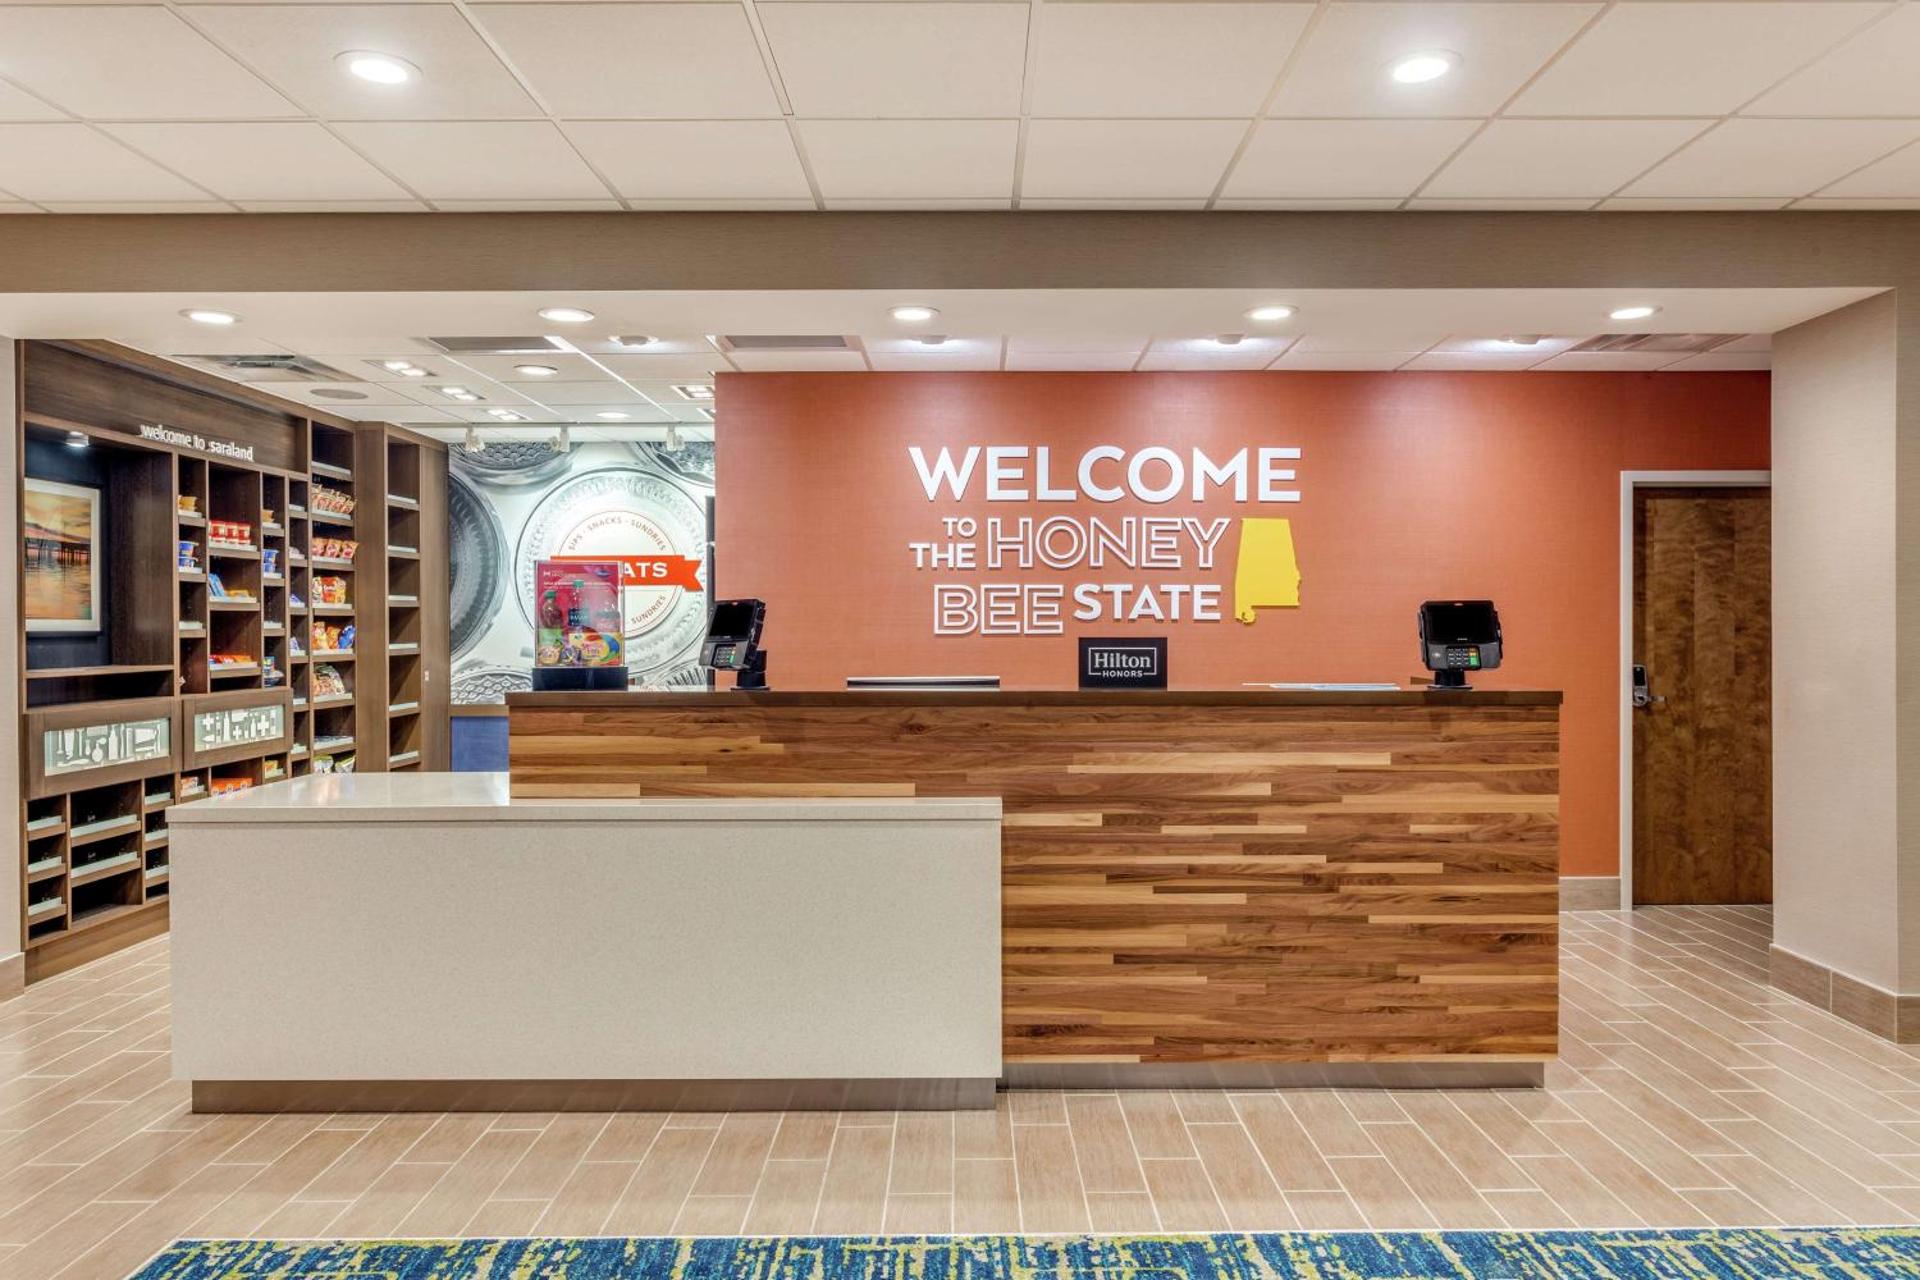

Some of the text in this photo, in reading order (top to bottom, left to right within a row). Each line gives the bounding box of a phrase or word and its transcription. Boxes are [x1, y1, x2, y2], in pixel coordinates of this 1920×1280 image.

[139, 425, 254, 462] welcome to saraland
[908, 446, 1301, 503] WELCOME
[568, 516, 667, 551] SIPS SNACKS SUNDRIES
[909, 516, 1231, 569] TO THE HONEY
[623, 562, 668, 578] ATS
[631, 595, 667, 624] SUNDRIES
[933, 583, 1222, 636] BEE STATE
[1094, 652, 1151, 668] Hilton
